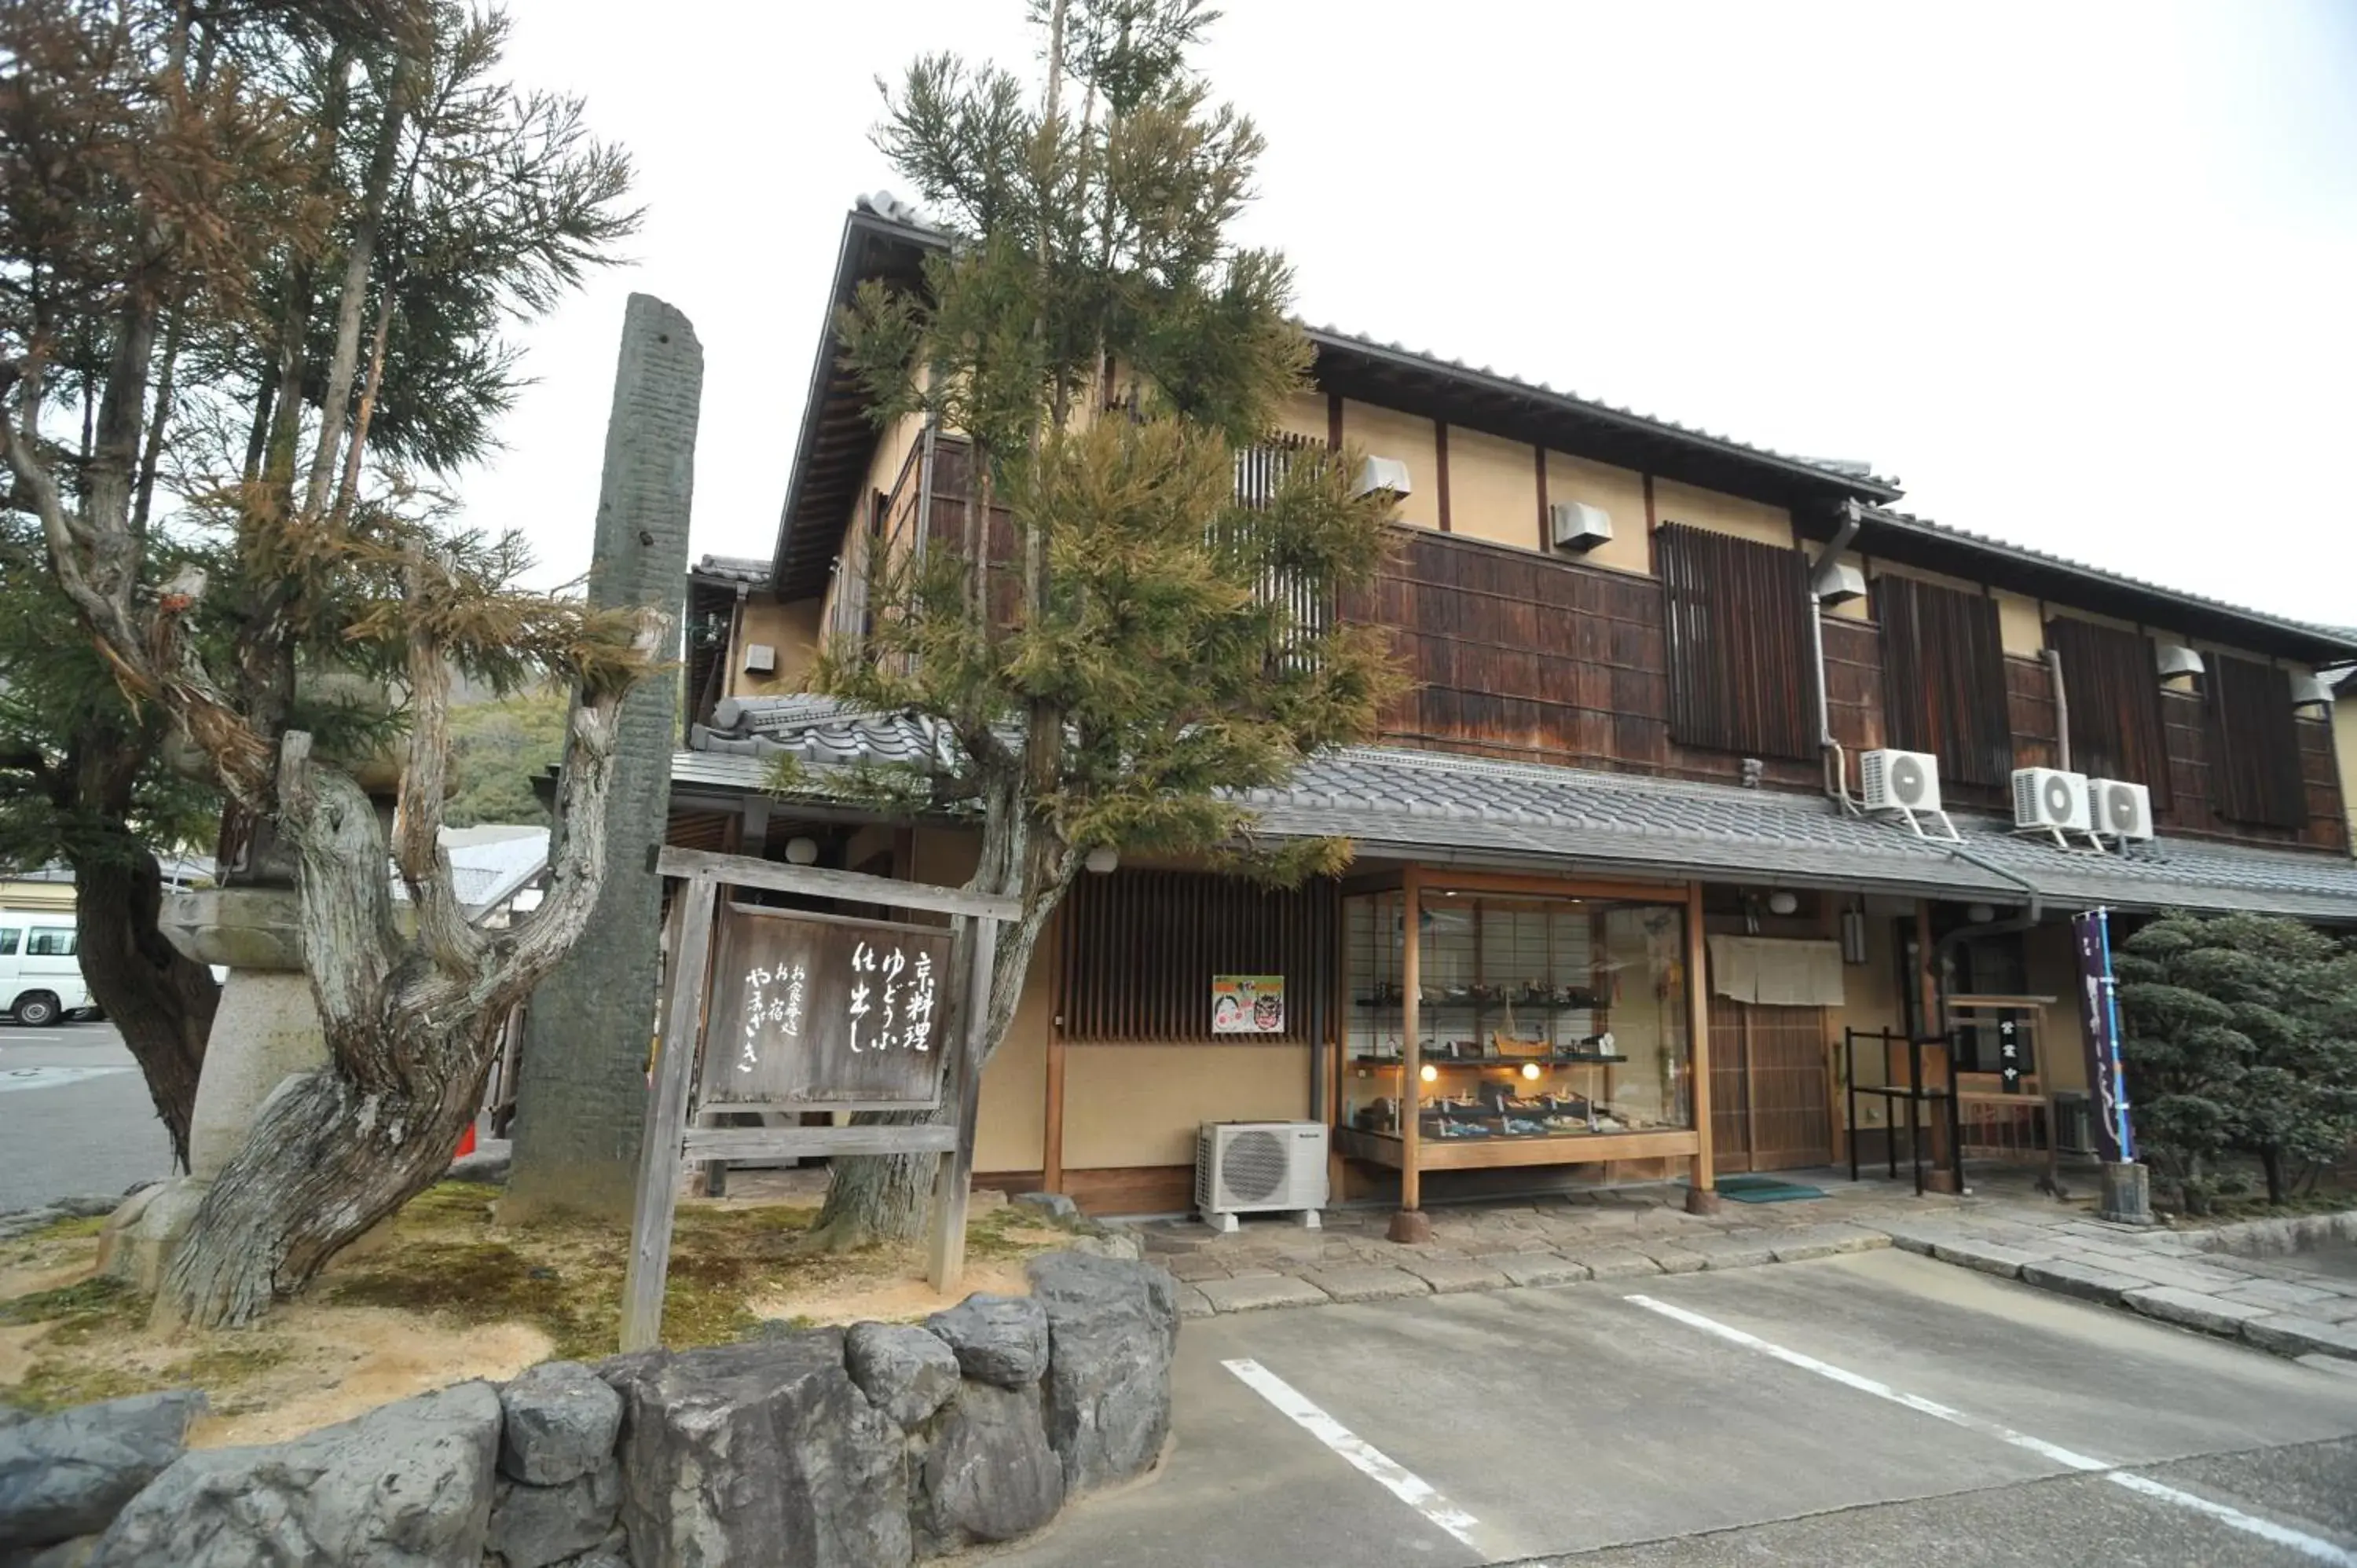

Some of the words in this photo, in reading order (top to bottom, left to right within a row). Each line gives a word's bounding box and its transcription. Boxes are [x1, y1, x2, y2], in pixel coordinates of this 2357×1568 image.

[768, 962, 789, 1021] お宿
[850, 941, 877, 1053] 仕出し
[871, 947, 906, 1051] ゆどうふ
[903, 951, 935, 1051] 京料理
